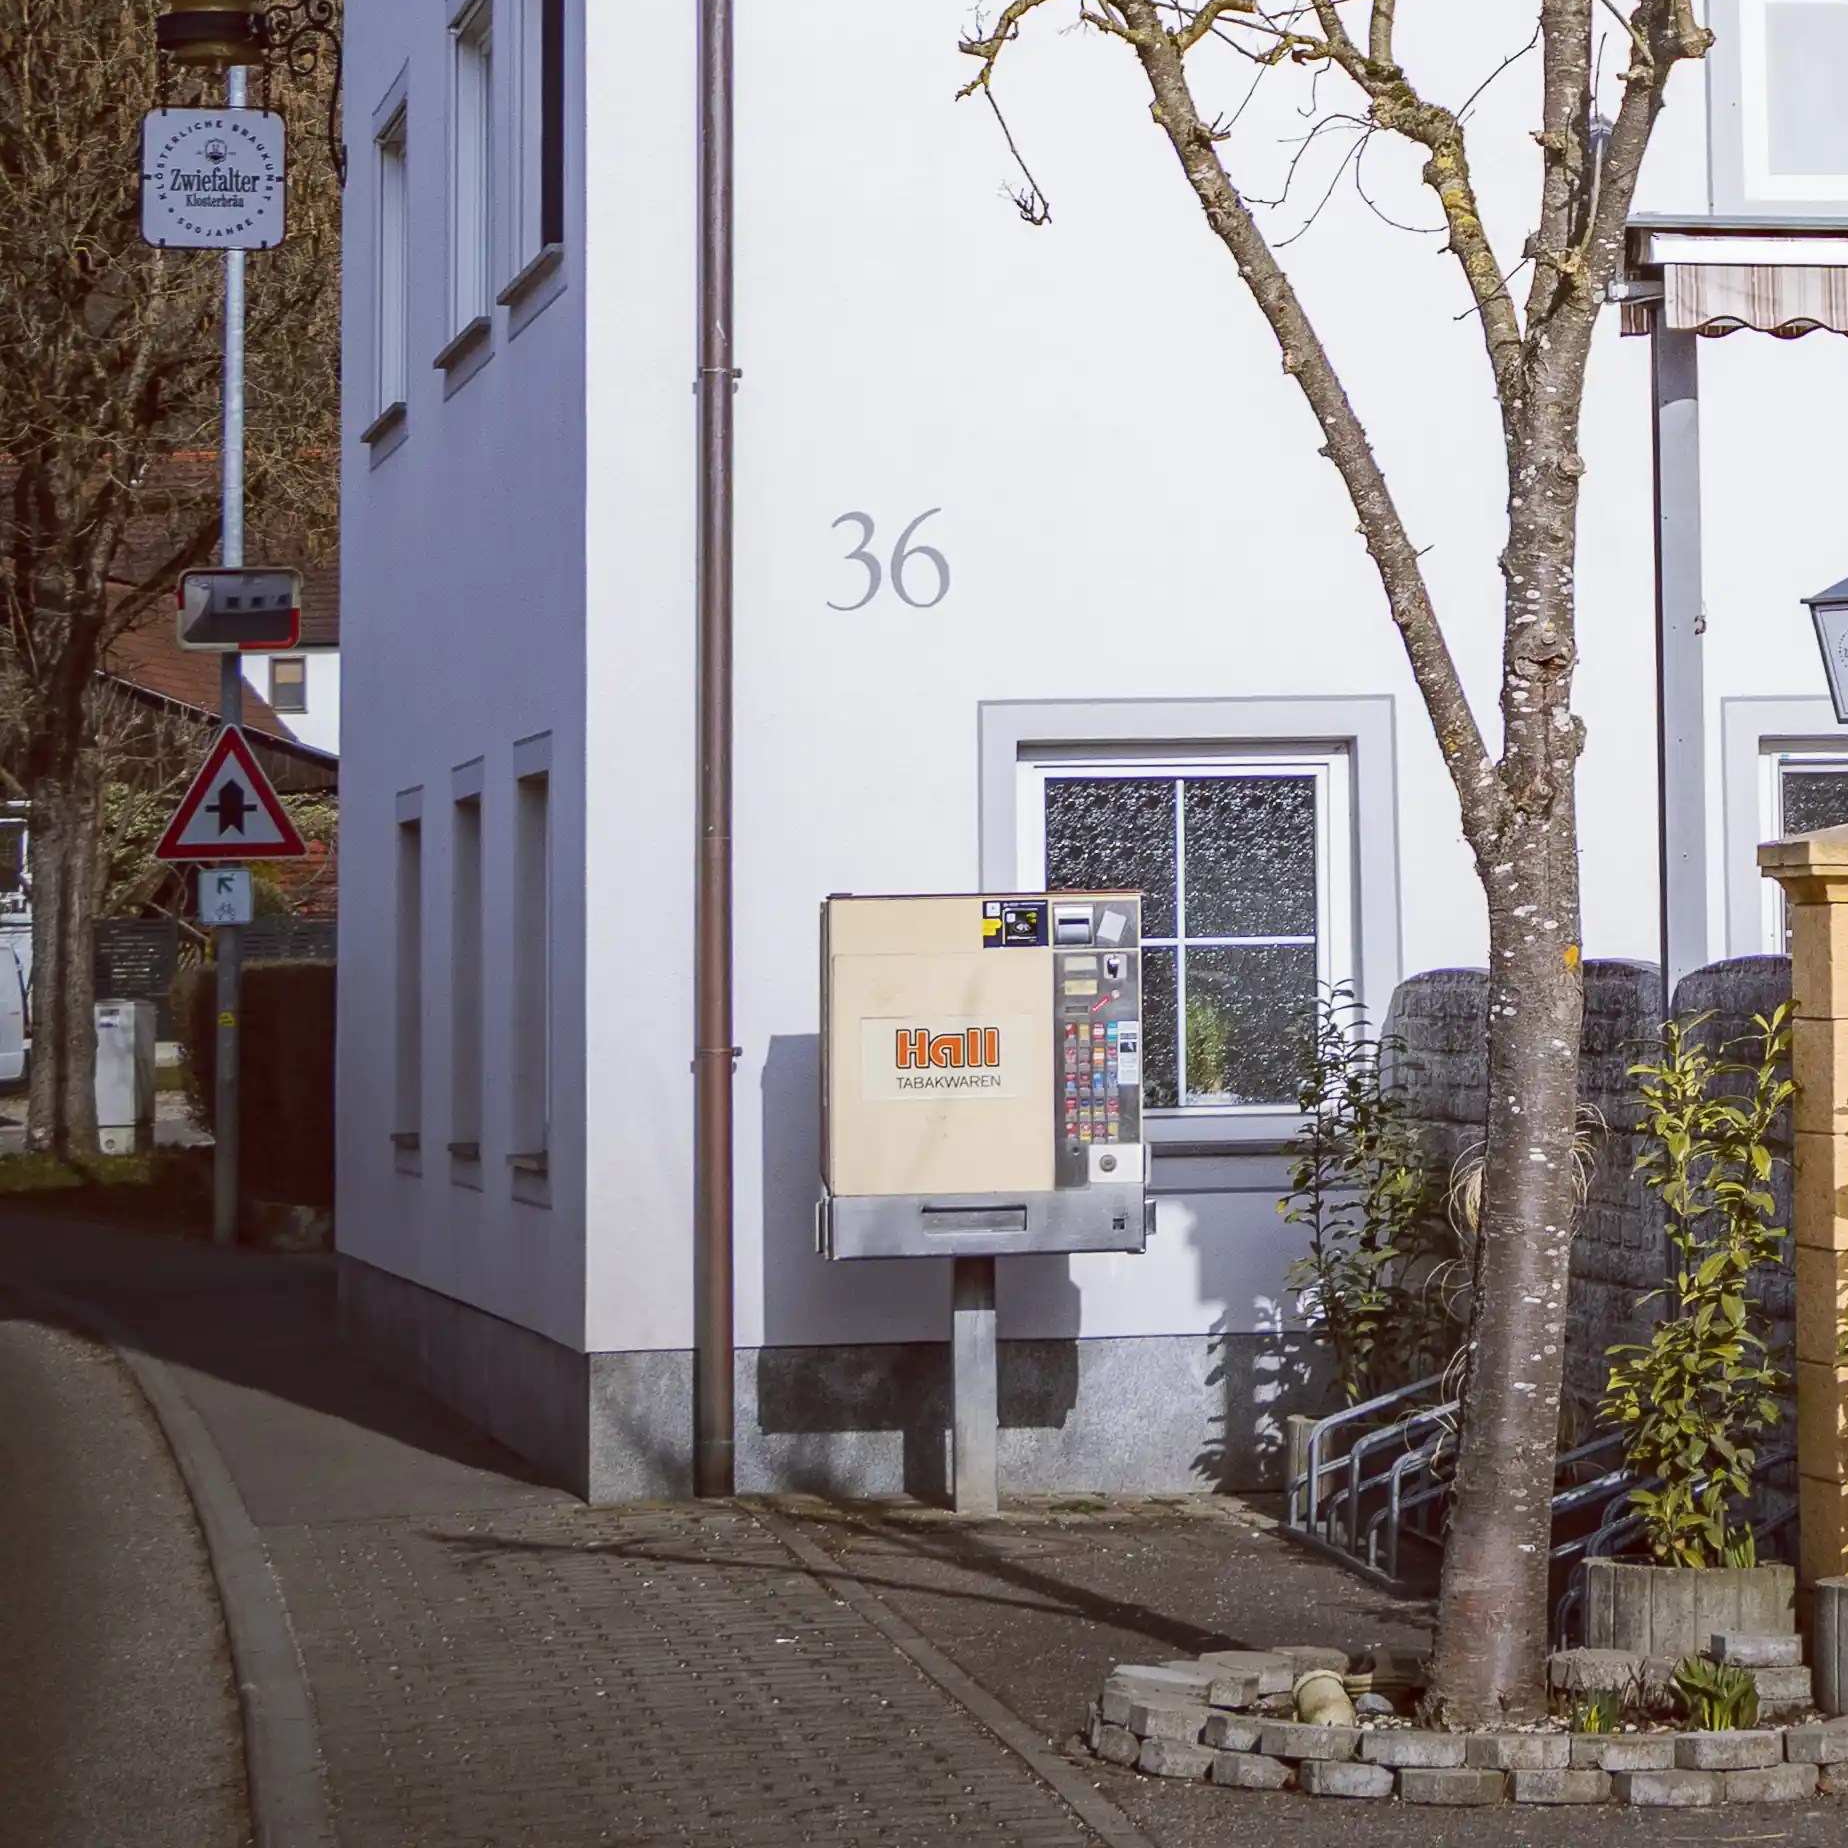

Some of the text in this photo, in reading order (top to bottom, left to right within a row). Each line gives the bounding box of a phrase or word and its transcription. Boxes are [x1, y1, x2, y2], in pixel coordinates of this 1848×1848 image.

[169, 166, 260, 193] Zwiefalter
[185, 193, 245, 208] Klosterbräu
[826, 507, 951, 611] 36
[896, 1027, 1000, 1069] Hall
[896, 1074, 1001, 1090] TABAKWAREN
